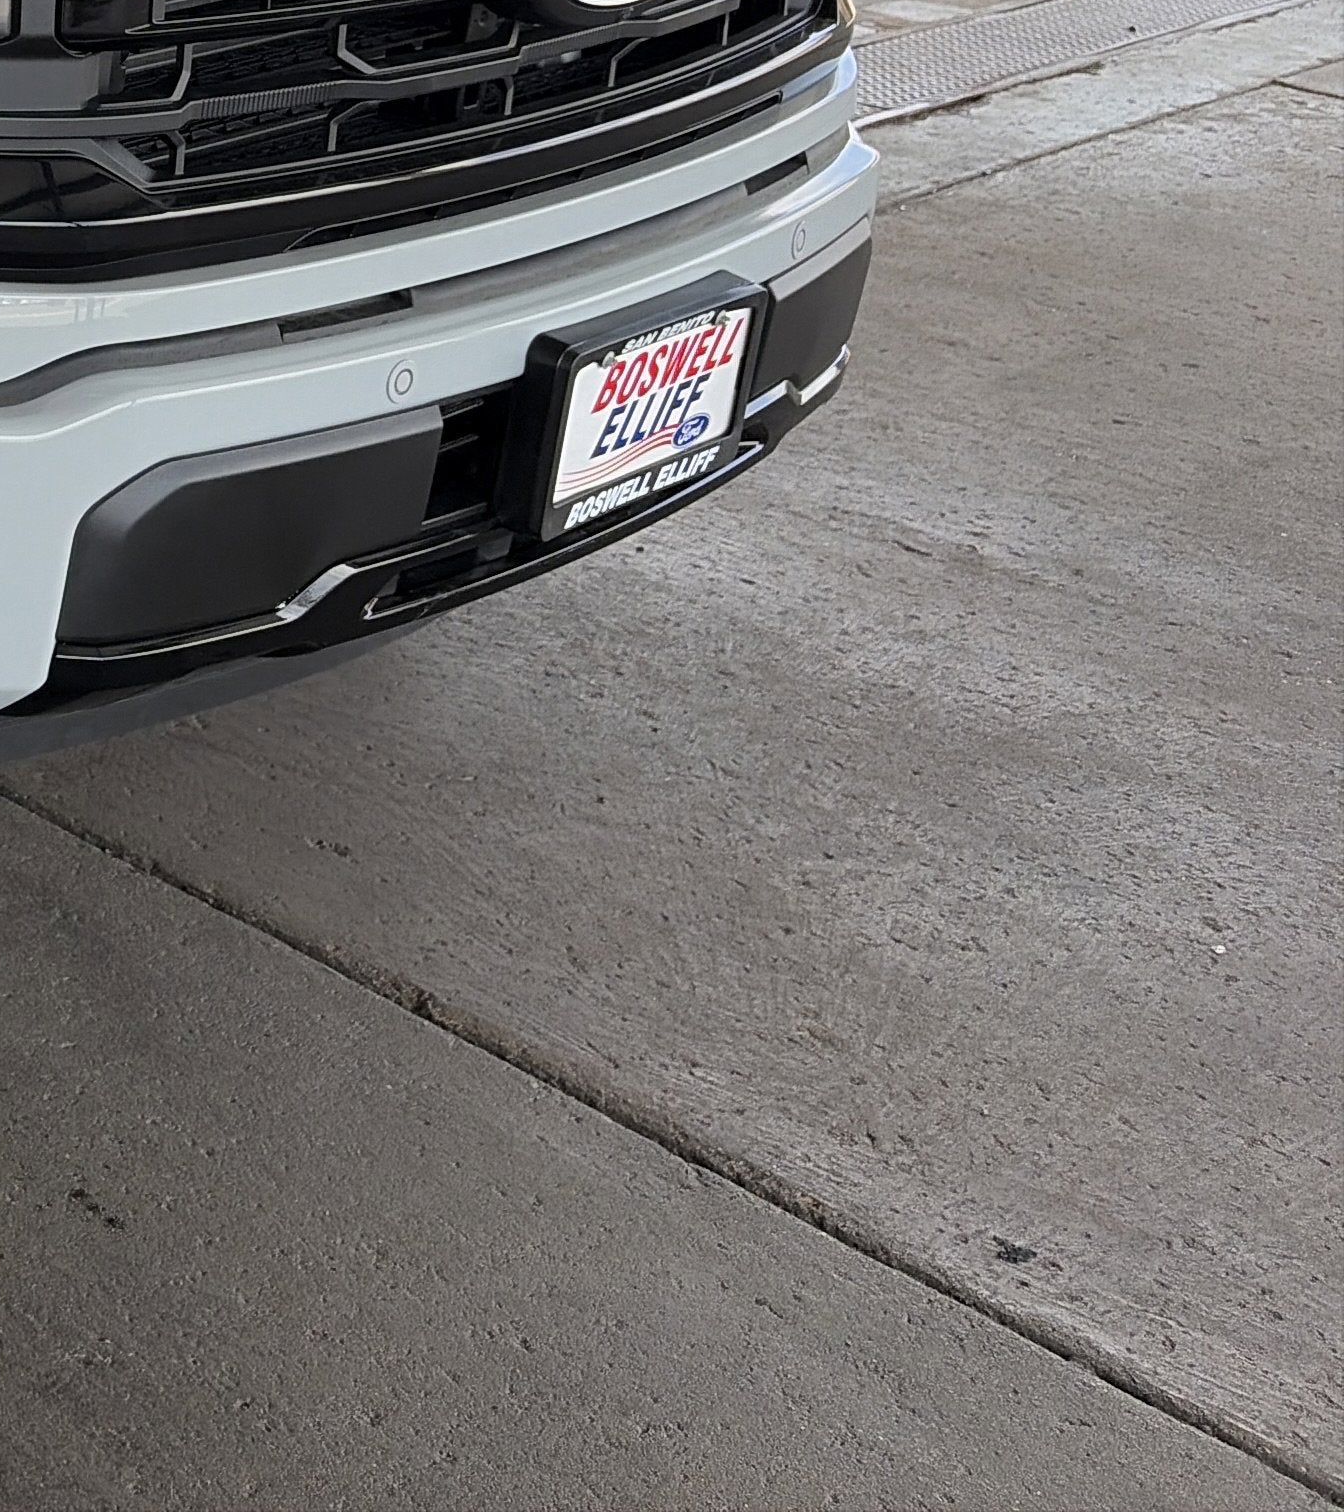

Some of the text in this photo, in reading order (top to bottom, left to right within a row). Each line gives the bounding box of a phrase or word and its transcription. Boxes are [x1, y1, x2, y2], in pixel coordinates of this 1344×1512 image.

[591, 317, 746, 415] BOSWELL
[621, 310, 716, 355] SAN BENITO
[588, 373, 712, 460] ELLIFF
[563, 445, 722, 531] BOSWELL ELLIFF
